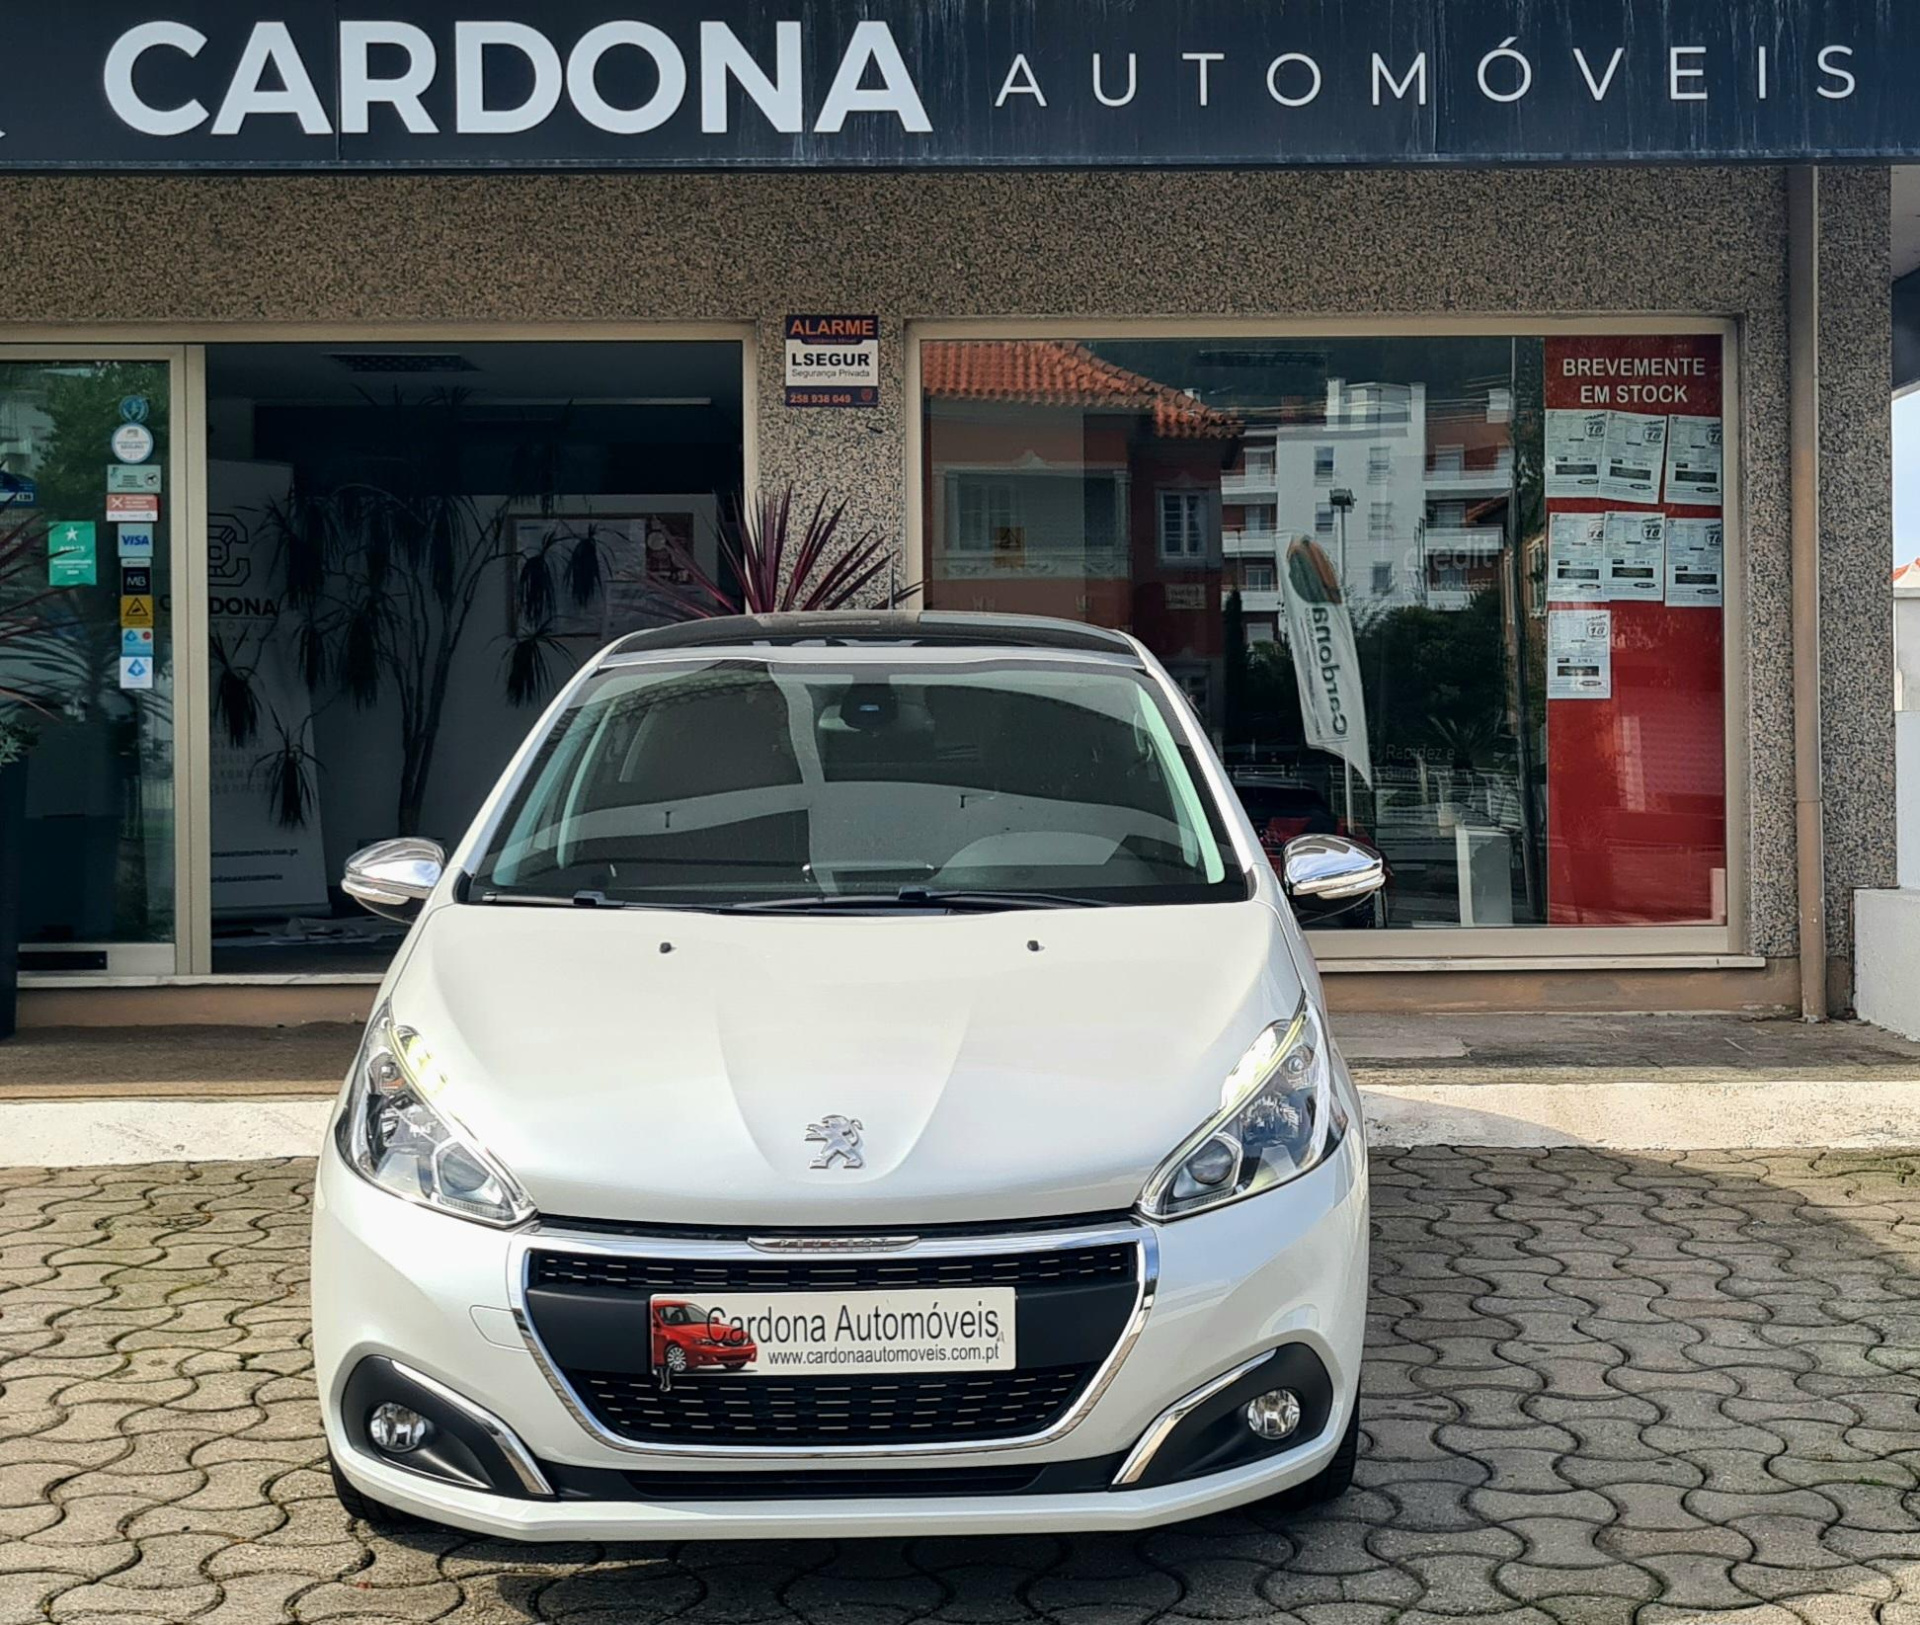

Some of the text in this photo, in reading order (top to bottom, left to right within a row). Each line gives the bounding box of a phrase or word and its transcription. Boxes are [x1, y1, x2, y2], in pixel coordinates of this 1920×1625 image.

[103, 19, 1857, 137] CARDONA AUTOMÓVEIS
[790, 319, 874, 335] ALARME
[791, 352, 870, 366] LSEGUR
[1562, 358, 1706, 376] BREVEMENTE
[791, 368, 870, 378] Segurança Privada
[1580, 384, 1688, 403] EM STOCK
[121, 535, 149, 545] VISA
[706, 1301, 999, 1344] Cardona Automóveis
[768, 1344, 1000, 1366] www.cardonaautomoveis.com.pt
